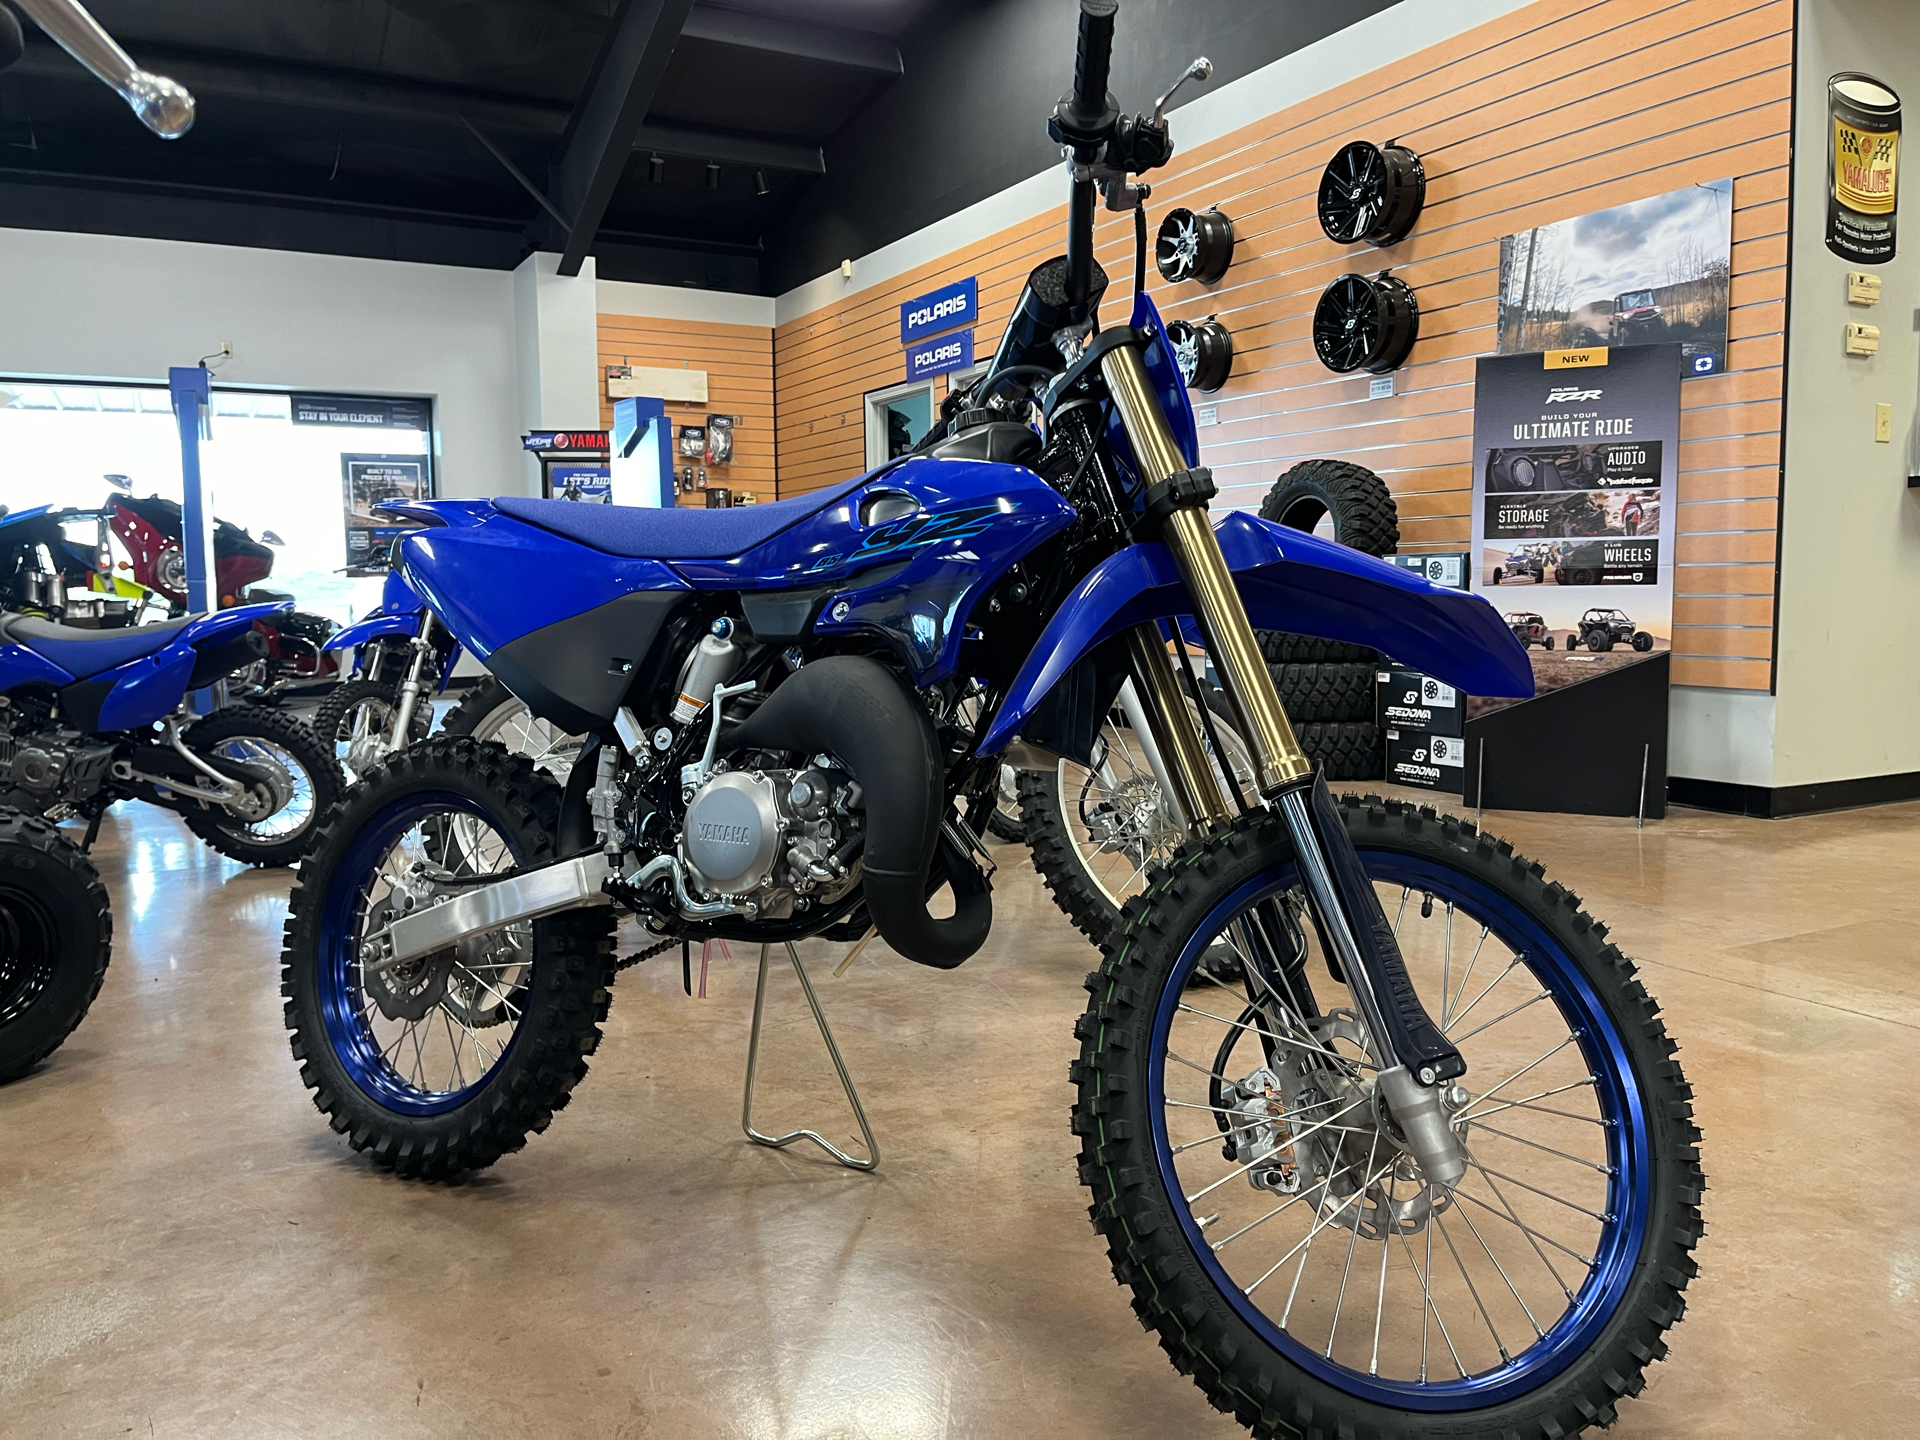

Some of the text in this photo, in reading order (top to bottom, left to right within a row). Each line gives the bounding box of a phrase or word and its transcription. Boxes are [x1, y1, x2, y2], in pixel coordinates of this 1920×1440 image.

[1842, 160, 1890, 193] YAMALUBE
[908, 293, 967, 329] POLARIS
[914, 342, 962, 368] POLARIS
[1562, 354, 1590, 364] NEW
[1545, 389, 1603, 405] RZR
[298, 411, 317, 421] STAY
[319, 412, 328, 421] IN
[328, 412, 349, 422] YOUR
[349, 413, 384, 424] ELEMENT
[1541, 413, 1570, 421] BUILD
[1513, 418, 1633, 440] ULTIMATE RIDE
[1607, 450, 1646, 466] AUDIO
[563, 476, 591, 486] LET'S
[1498, 509, 1549, 523] STORAGE
[1604, 548, 1652, 562] WHEELS
[1384, 706, 1432, 719] SEDONA
[1394, 763, 1440, 778] SEDONA
[699, 822, 750, 845] YAMAHA
[1371, 920, 1430, 1032] YAMAHA
